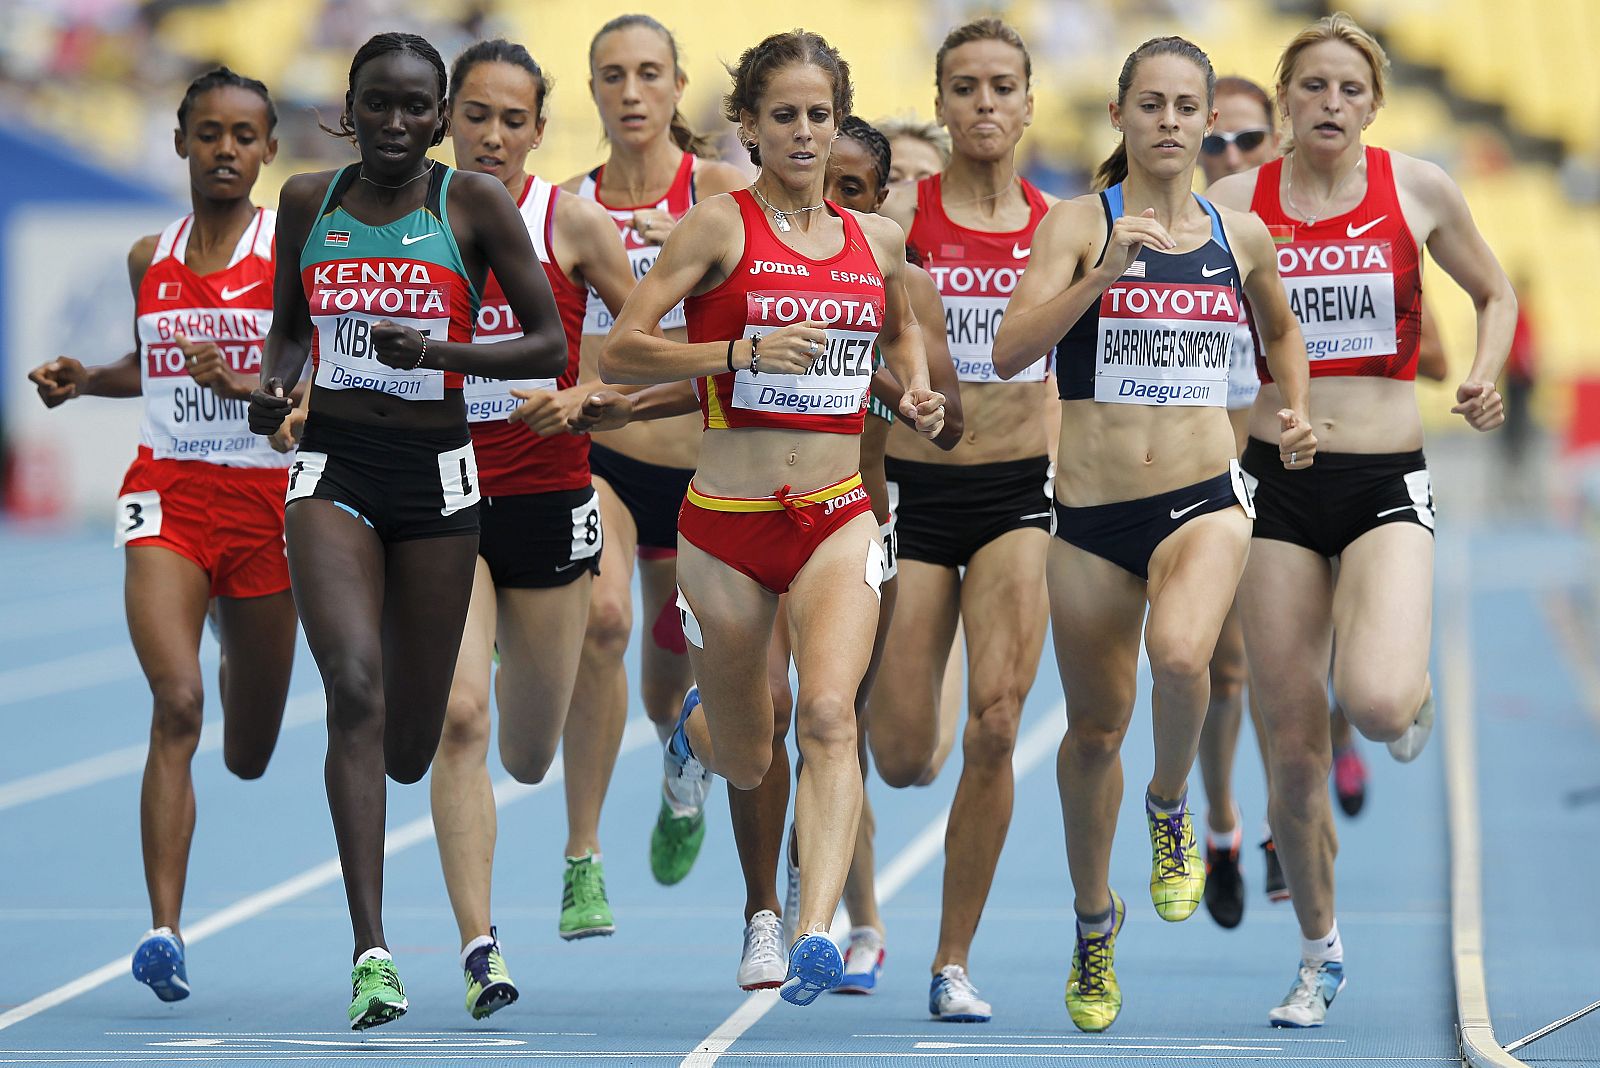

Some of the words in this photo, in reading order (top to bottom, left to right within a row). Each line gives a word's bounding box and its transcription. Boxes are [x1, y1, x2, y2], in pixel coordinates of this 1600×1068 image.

[1276, 245, 1388, 273] OYOTA
[314, 262, 431, 285] KENYA
[831, 270, 884, 289] ESPAÑA
[930, 266, 1026, 294] TOYO
[318, 288, 445, 313] TOYOTA
[754, 296, 878, 328] TOYOTA
[1108, 287, 1235, 317] TOYOTA
[1290, 285, 1376, 324] AREIVA
[157, 313, 259, 341] BAHRAIN
[1103, 329, 1177, 368] BARRINGER
[1178, 330, 1231, 368] SIMPSON
[1341, 337, 1374, 352] 2011
[387, 380, 421, 394] 2011
[758, 387, 822, 413] Daegu
[823, 394, 855, 409] 2011
[1118, 378, 1181, 404] Daegu
[1183, 385, 1210, 400] 2011
[224, 436, 256, 451] 2011
[125, 502, 145, 533] 3
[584, 508, 598, 546] 8
